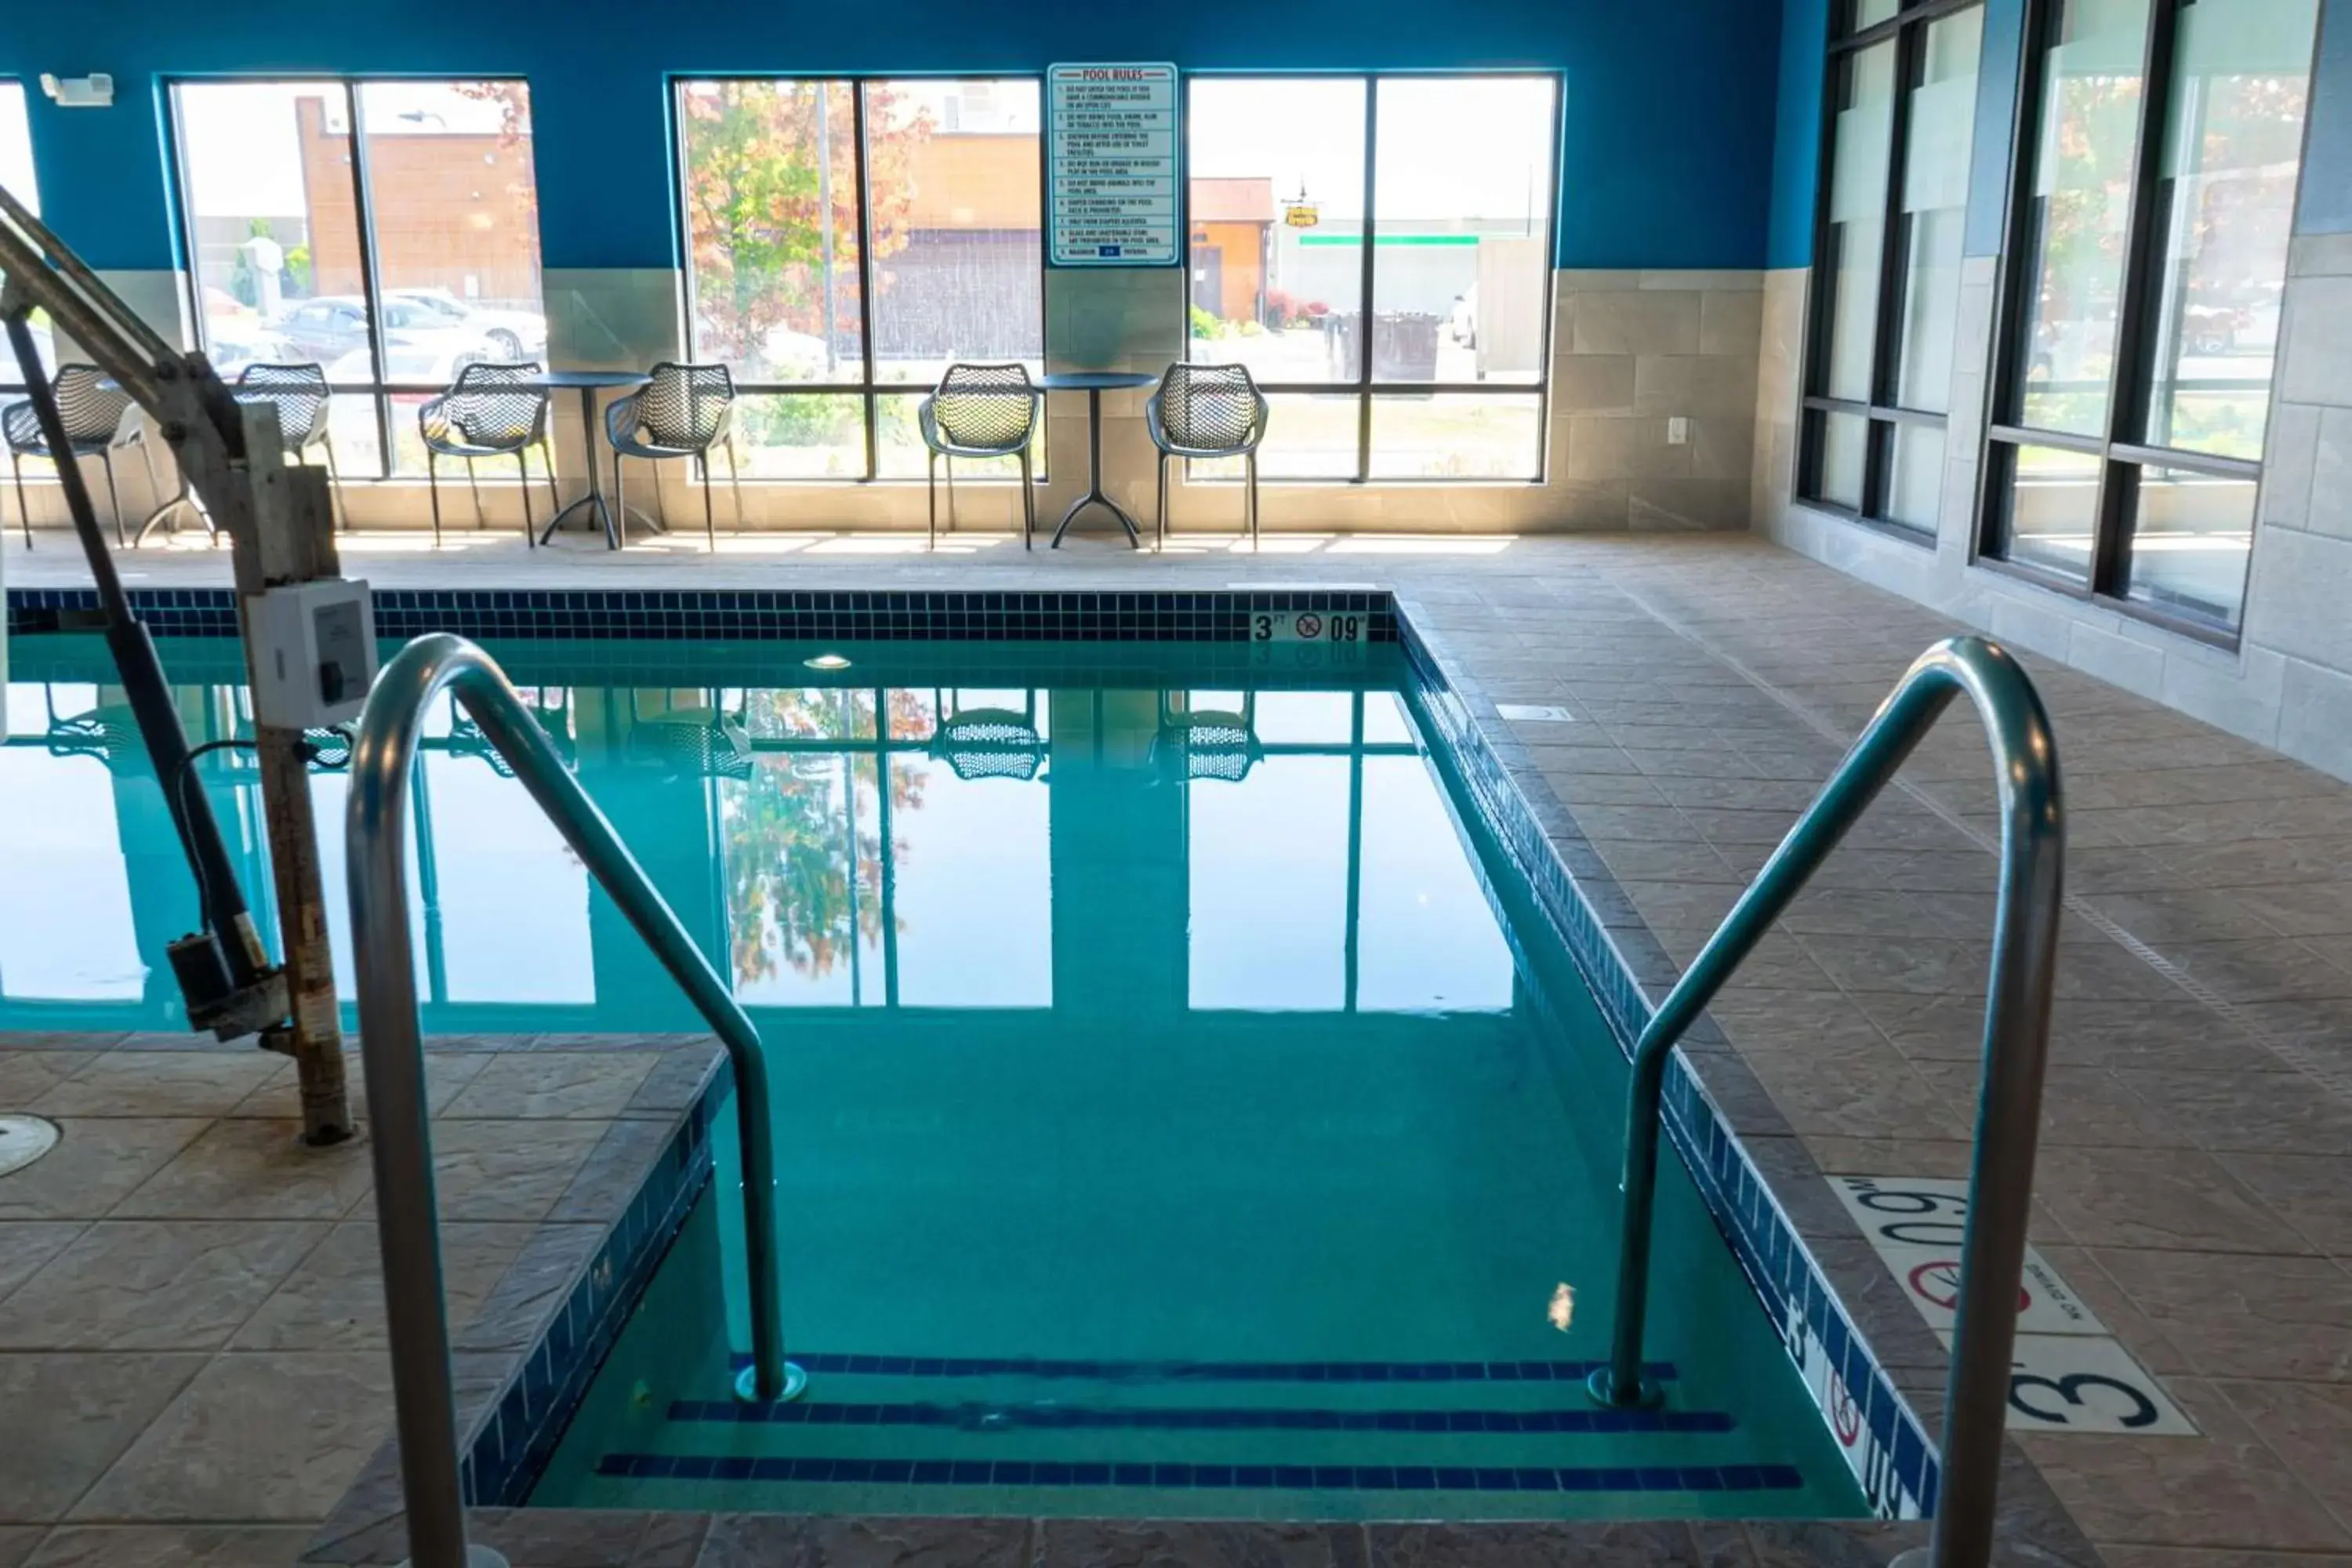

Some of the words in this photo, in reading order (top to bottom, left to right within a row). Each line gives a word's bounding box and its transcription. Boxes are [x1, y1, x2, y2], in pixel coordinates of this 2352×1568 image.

[1083, 69, 1110, 81] POOL
[1112, 69, 1142, 81] RULES
[1255, 615, 1272, 640] 3
[2008, 1374, 2158, 1428] 3
